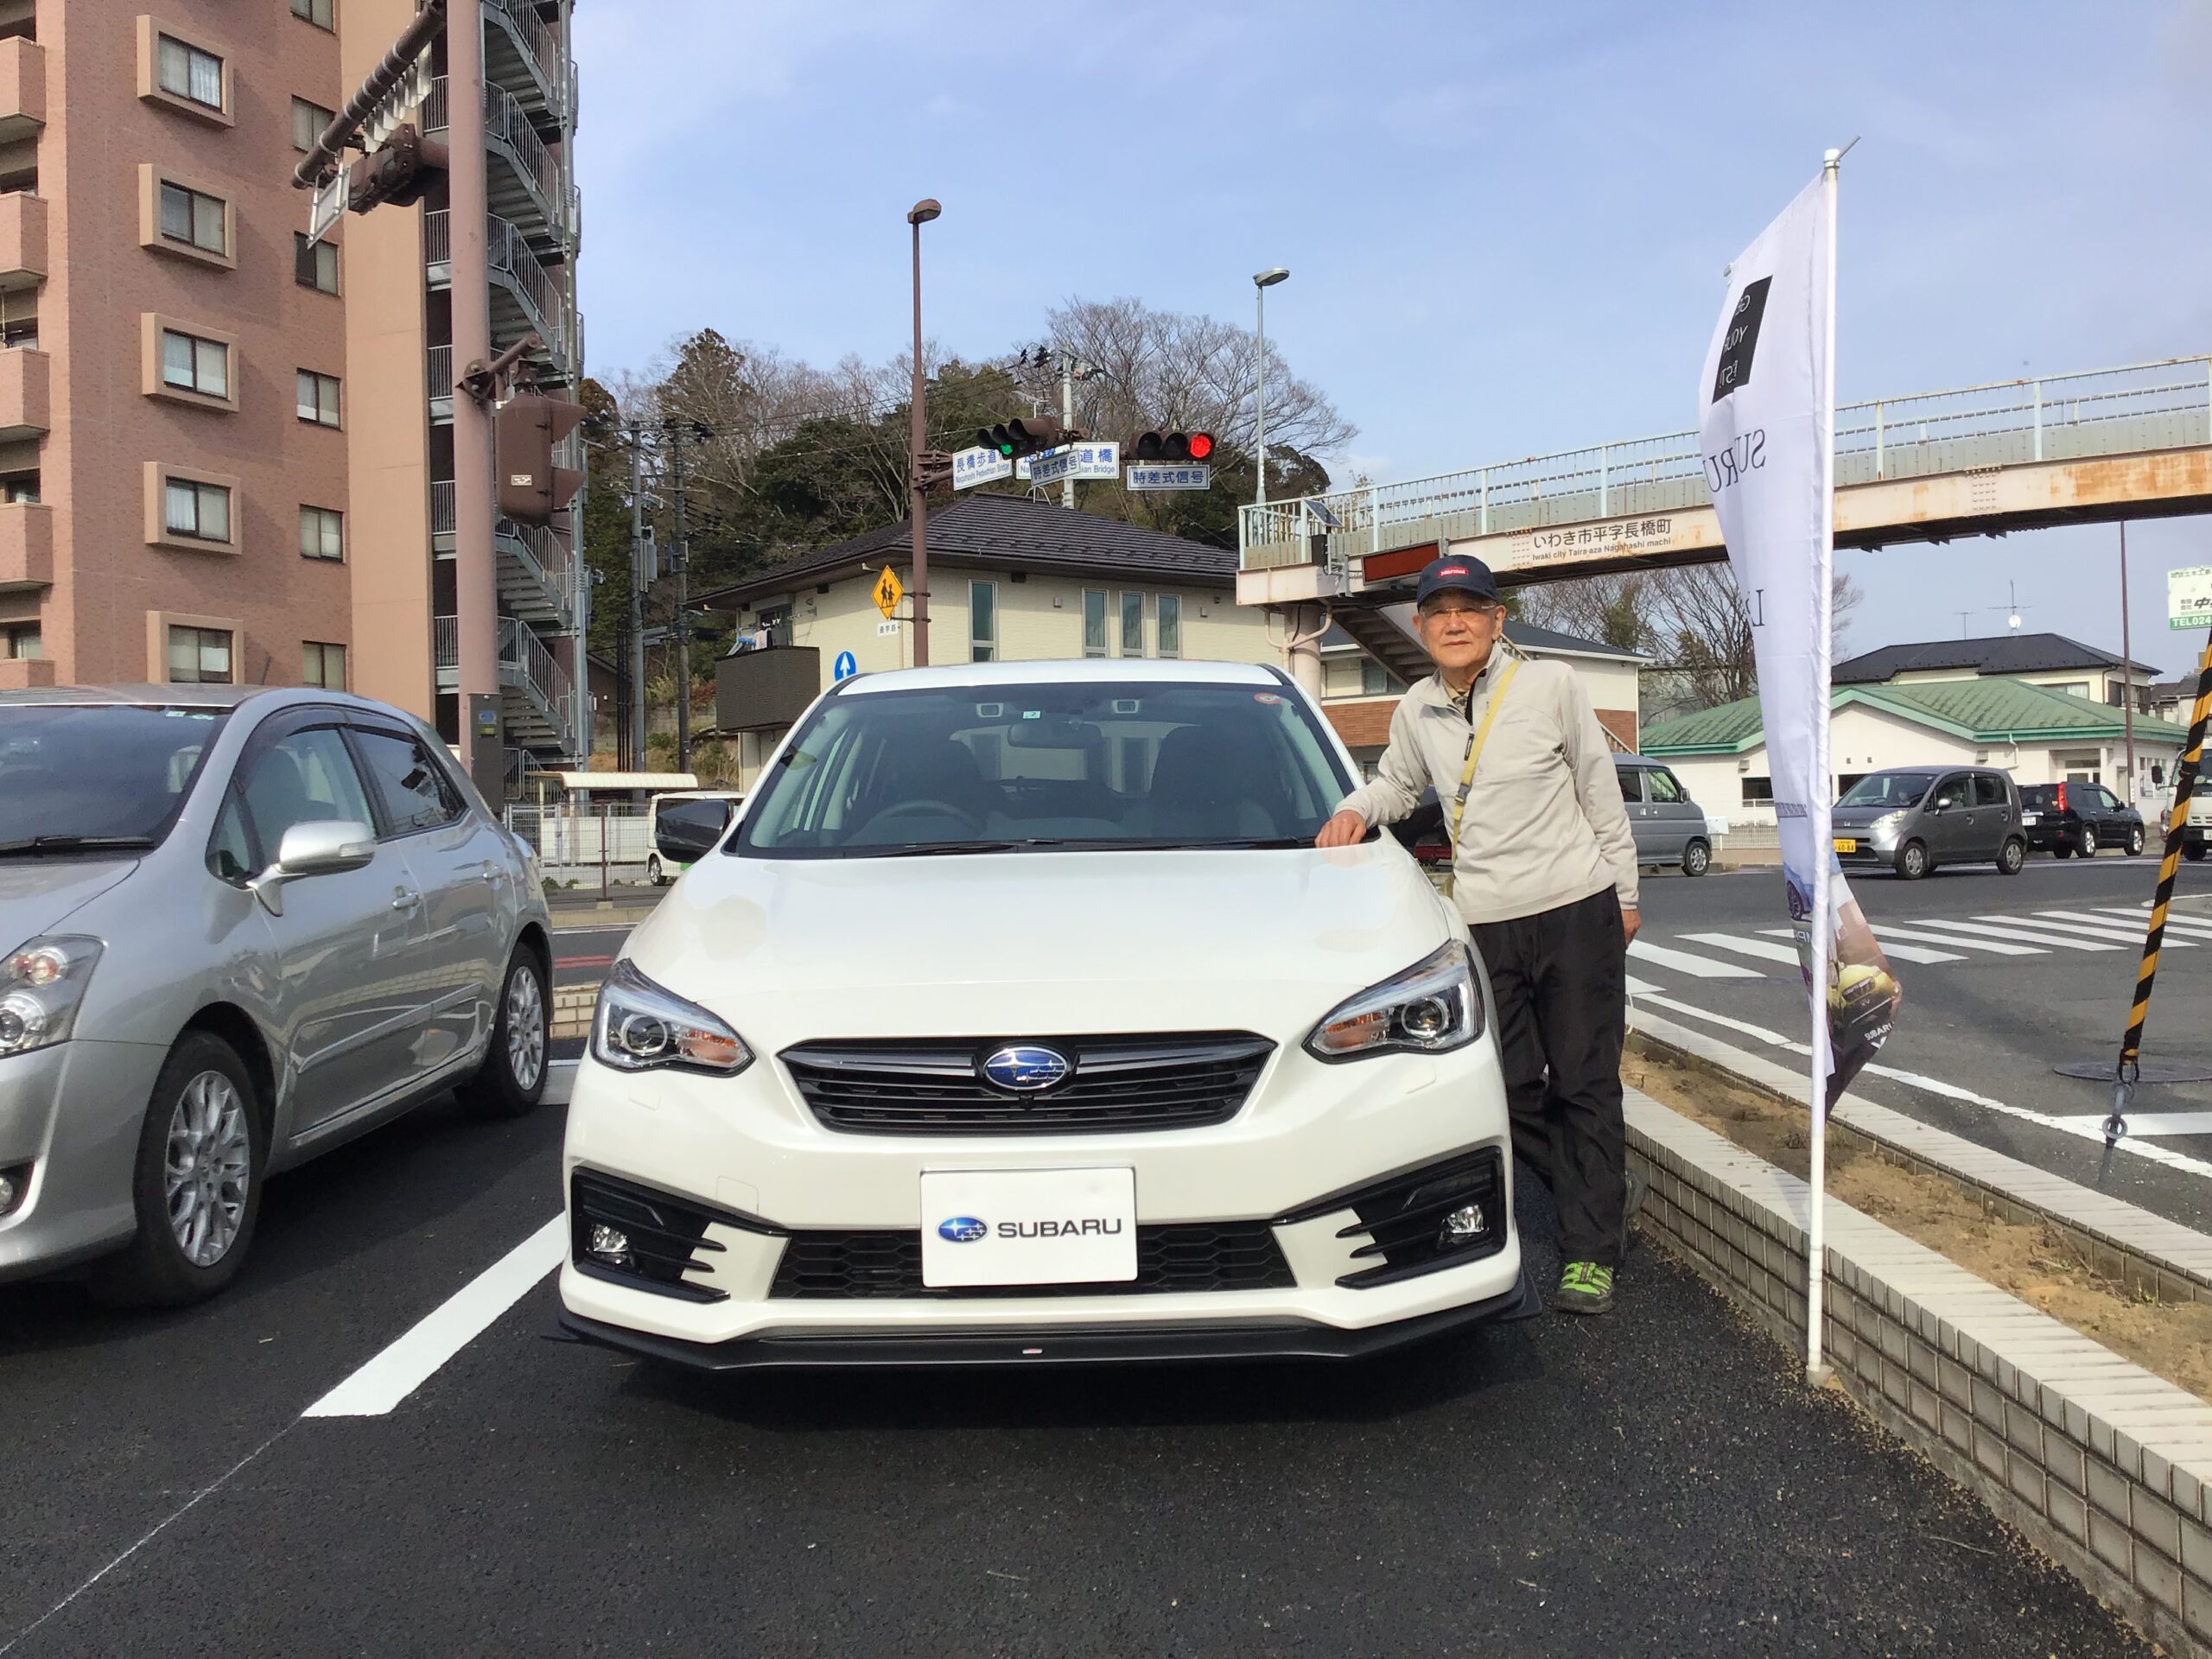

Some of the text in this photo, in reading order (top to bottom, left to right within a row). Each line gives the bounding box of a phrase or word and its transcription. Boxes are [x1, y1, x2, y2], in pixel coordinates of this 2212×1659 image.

[957, 449, 1001, 473] 長橋歩道
[1033, 455, 1077, 480] 時差式信号
[1133, 471, 1205, 485] 時差式信号
[1534, 518, 1672, 549] いわき市平字長橋町
[1533, 552, 1551, 561] Iwaki
[1553, 550, 1567, 559] city
[1647, 537, 1671, 547] machi
[997, 1218, 1122, 1238] SUBARU
